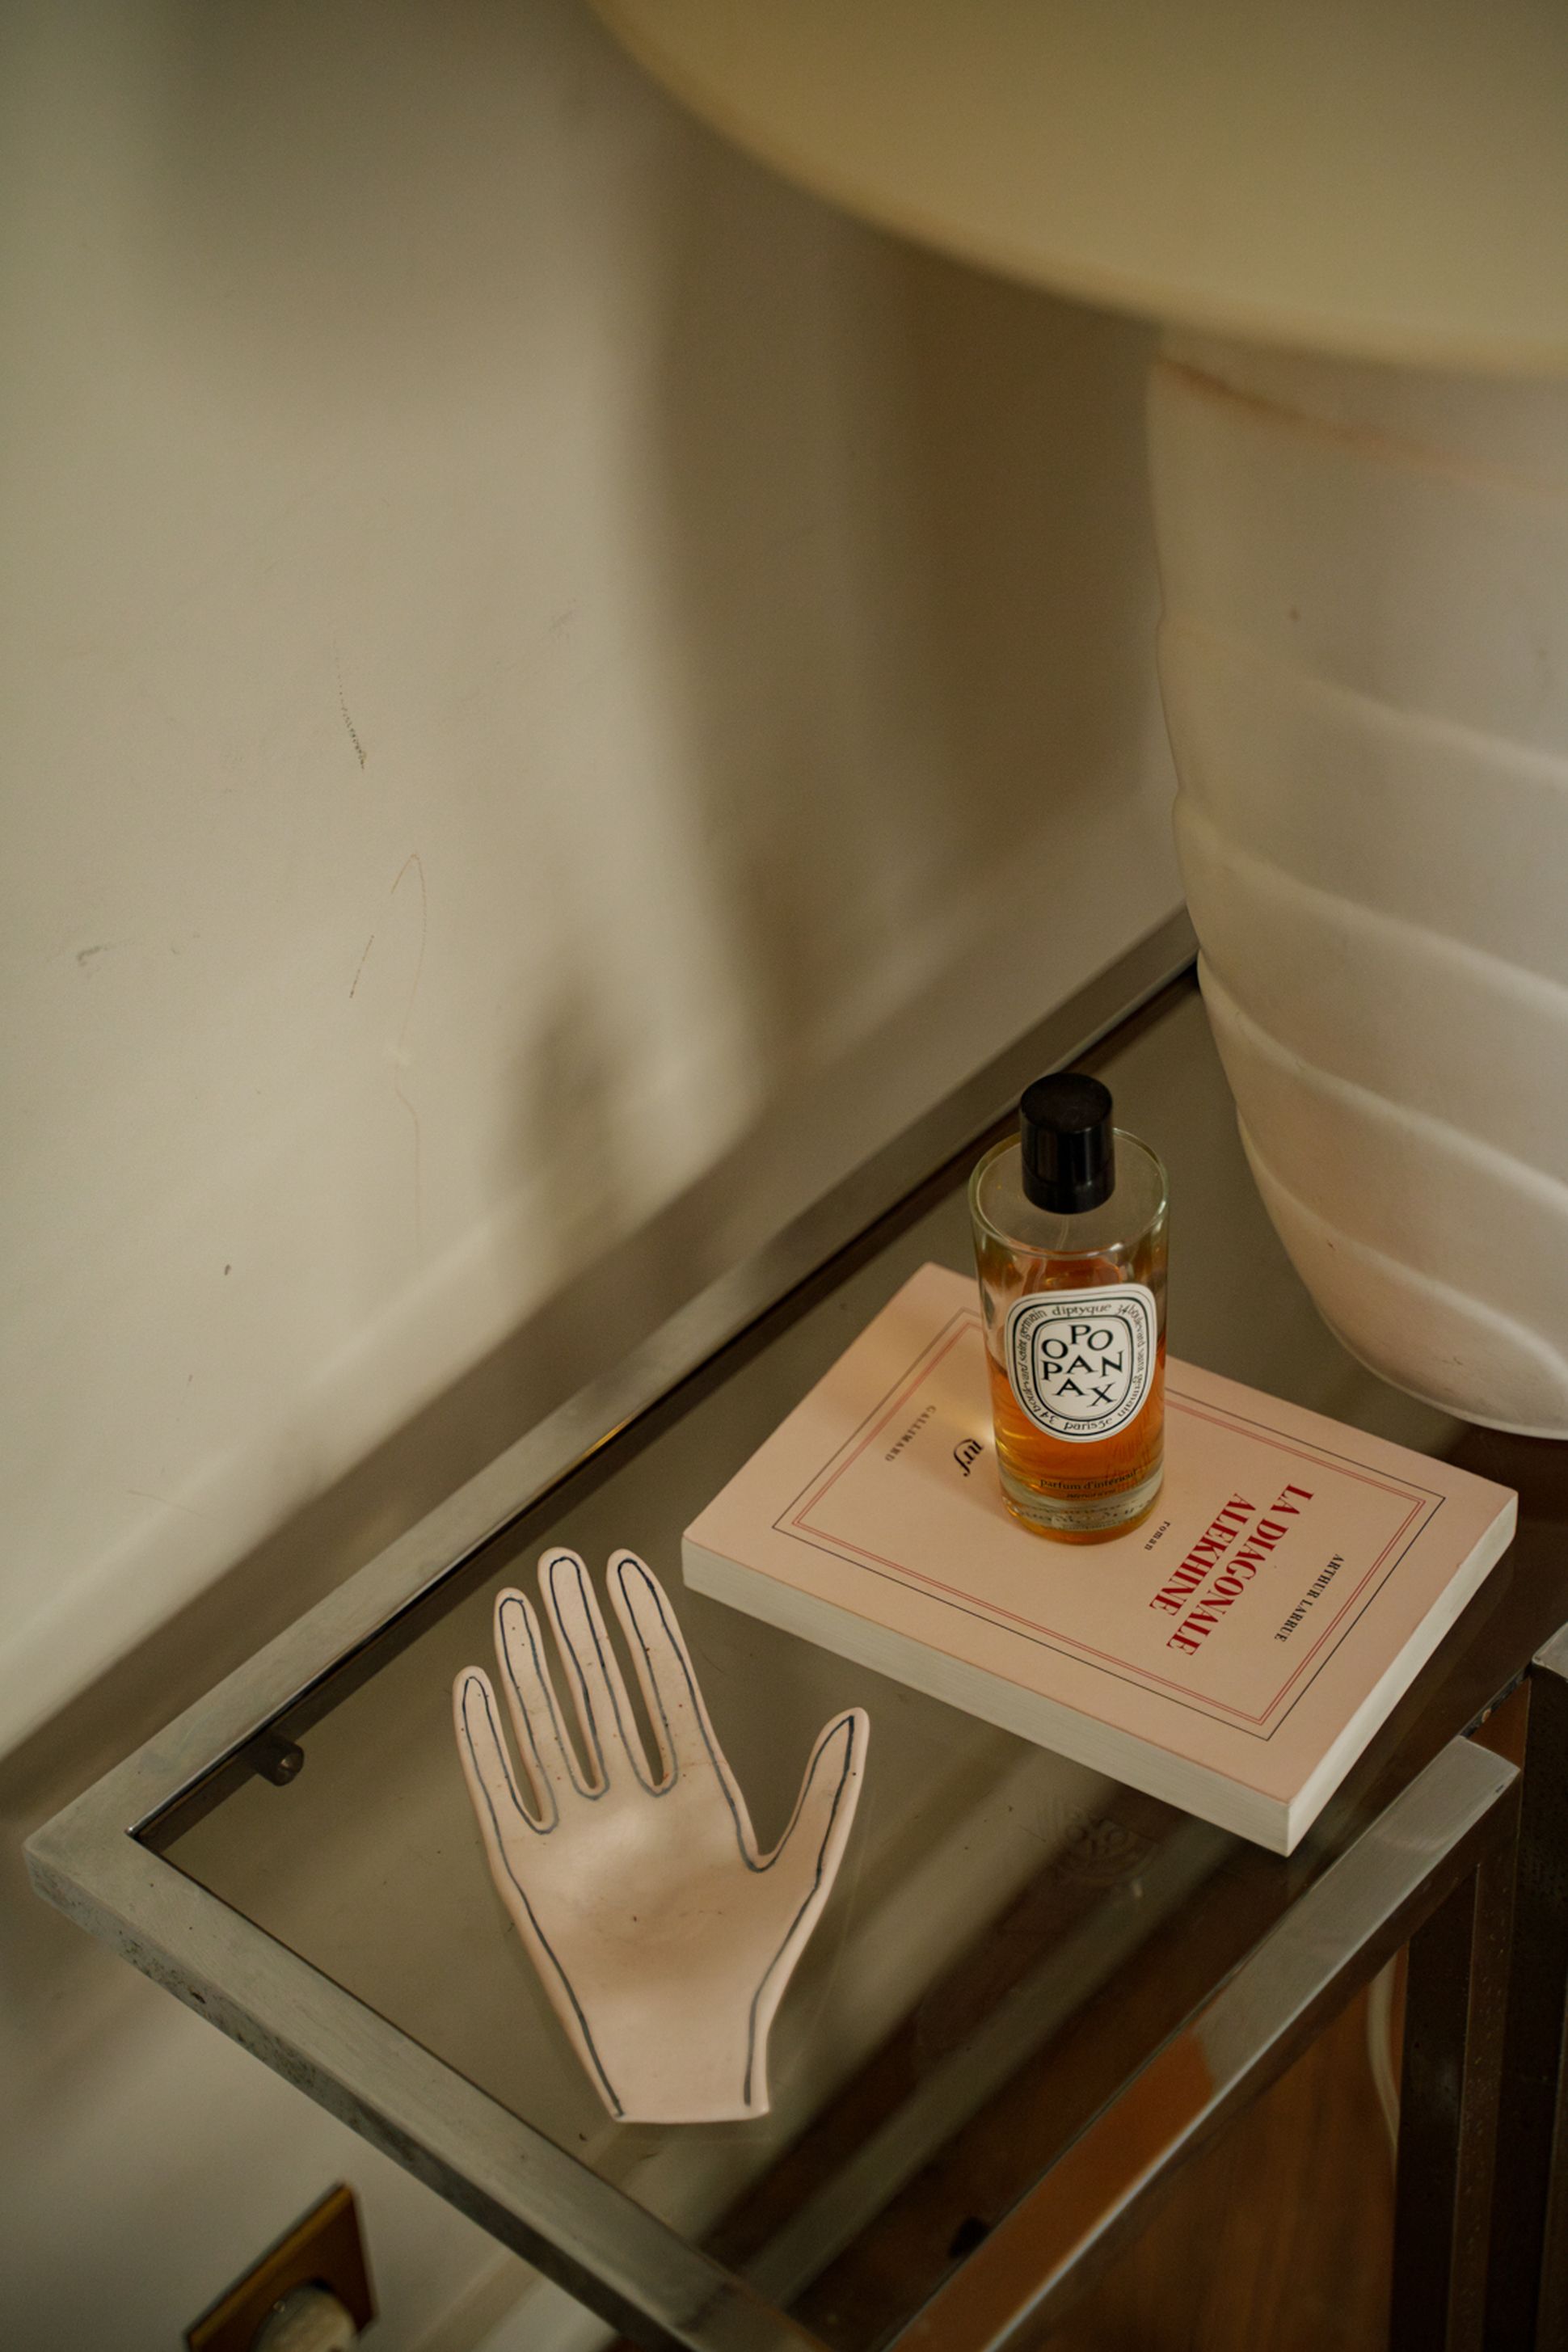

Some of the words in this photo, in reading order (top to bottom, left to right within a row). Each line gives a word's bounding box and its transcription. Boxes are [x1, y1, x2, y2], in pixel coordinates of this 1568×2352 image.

[1018, 1309, 1048, 1342] germain
[1052, 1304, 1112, 1317] diptyque
[1018, 1340, 1027, 1364] saint
[1018, 1363, 1042, 1413] boulevard
[1052, 1377, 1118, 1408] AX
[884, 1405, 937, 1462] GALLIMARD
[953, 1438, 984, 1477] nrf
[1039, 1478, 1081, 1490] parfum
[1270, 1483, 1314, 1515] LA
[1144, 1520, 1171, 1551] roman
[1149, 1493, 1257, 1616] ALEKHINE
[1165, 1518, 1290, 1656] DIAGONALE
[1305, 1553, 1346, 1600] ARTHUR
[1274, 1599, 1314, 1643] LARRUE
